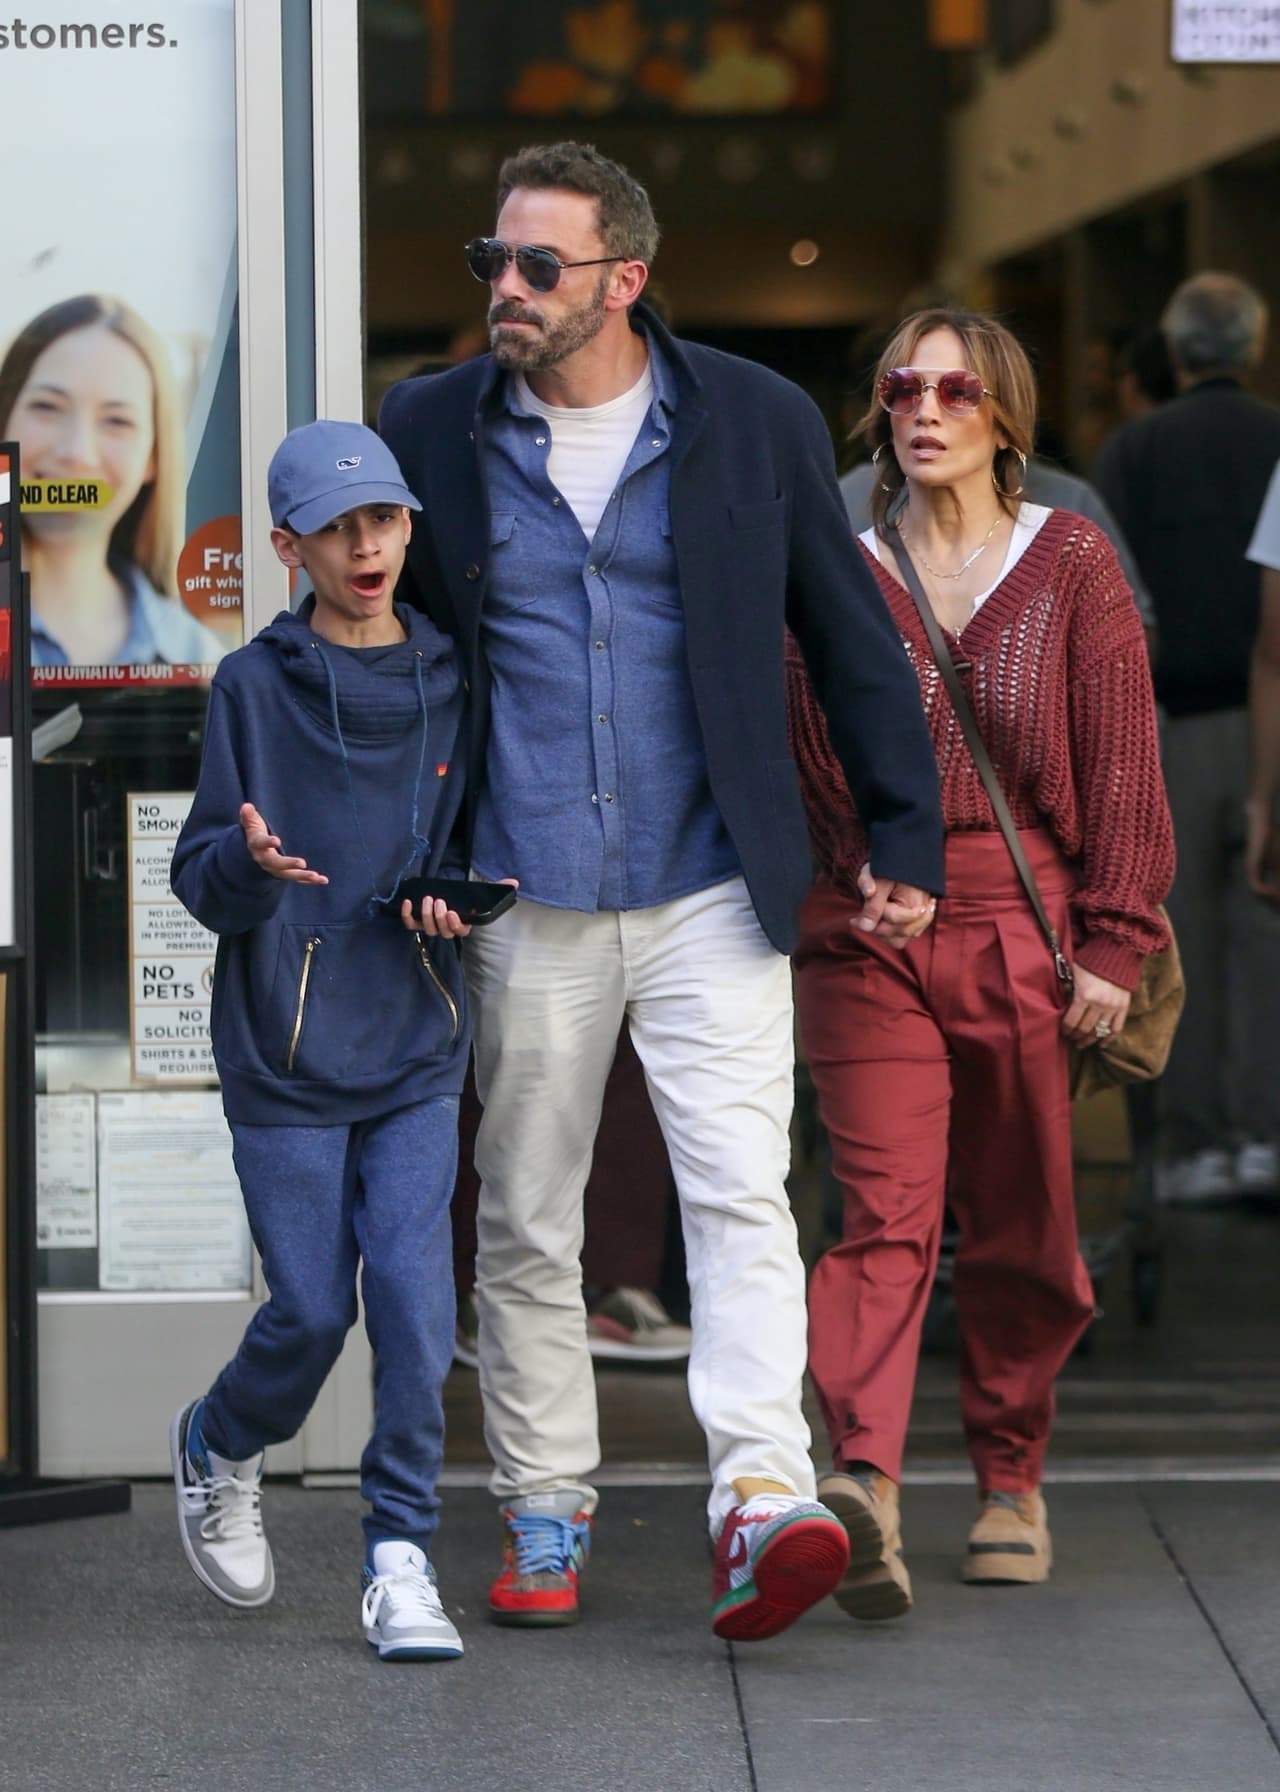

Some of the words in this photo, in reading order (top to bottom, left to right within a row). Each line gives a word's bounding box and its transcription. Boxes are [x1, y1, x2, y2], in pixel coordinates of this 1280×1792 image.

[0, 18, 178, 49] stomers.
[47, 484, 98, 504] CLEAR
[185, 576, 211, 591] gift
[209, 593, 240, 608] sign
[33, 665, 125, 681] AUTOMATIC
[129, 664, 173, 680] DOOR
[138, 806, 160, 817] NO
[148, 910, 163, 918] NO
[148, 921, 197, 929] ALLOWED
[154, 931, 187, 939] FRONT
[143, 965, 175, 981] NO
[143, 984, 194, 999] PETS
[179, 1010, 203, 1022] NO
[141, 1050, 185, 1060] SHIRTS
